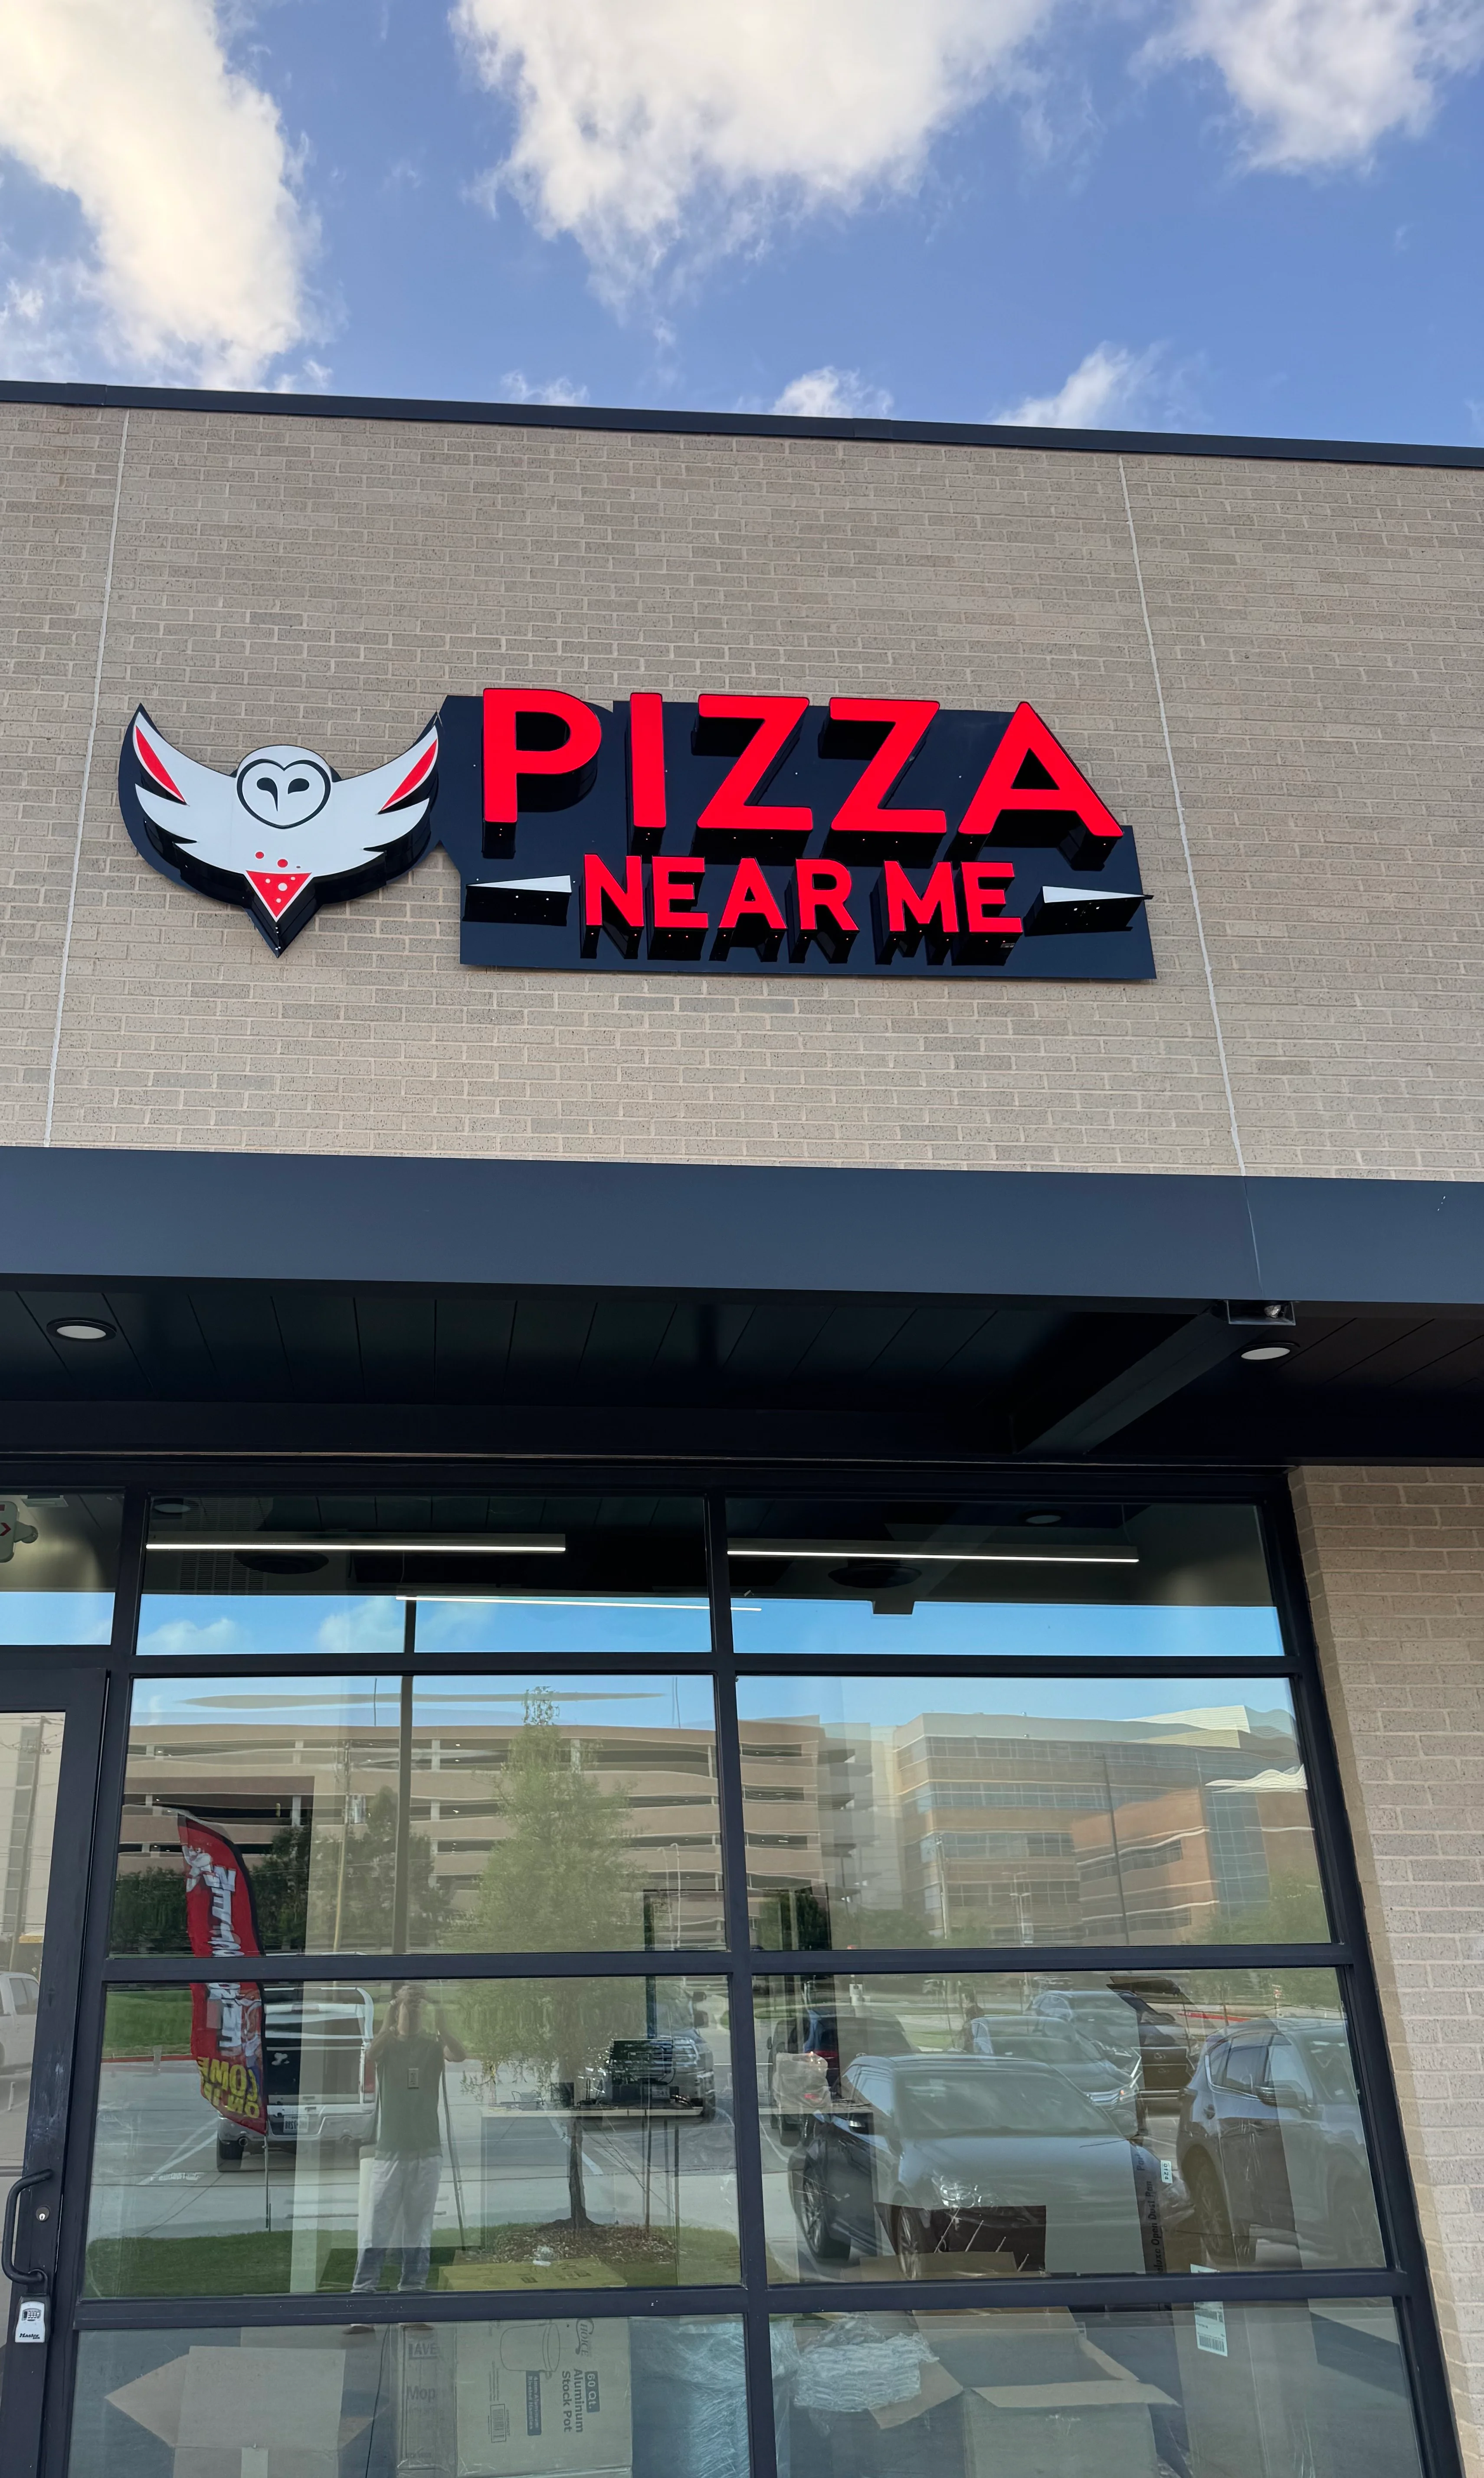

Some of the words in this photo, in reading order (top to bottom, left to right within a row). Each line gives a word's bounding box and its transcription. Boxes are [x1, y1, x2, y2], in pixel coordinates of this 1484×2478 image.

[483, 688, 1124, 837] PIZZA
[584, 854, 858, 931] NEAR
[884, 860, 1023, 933] ME
[1148, 2200, 1157, 2222] Dust
[1151, 2223, 1162, 2246] Open
[1153, 2248, 1163, 2275] eluxe
[576, 2318, 594, 2357] CHOICE
[562, 2370, 572, 2407] Stock
[587, 2373, 596, 2387] 60
[408, 2386, 436, 2403] Mop
[574, 2368, 584, 2433] Aluminum
[587, 2391, 597, 2409] Qt.
[563, 2410, 573, 2432] Pot
